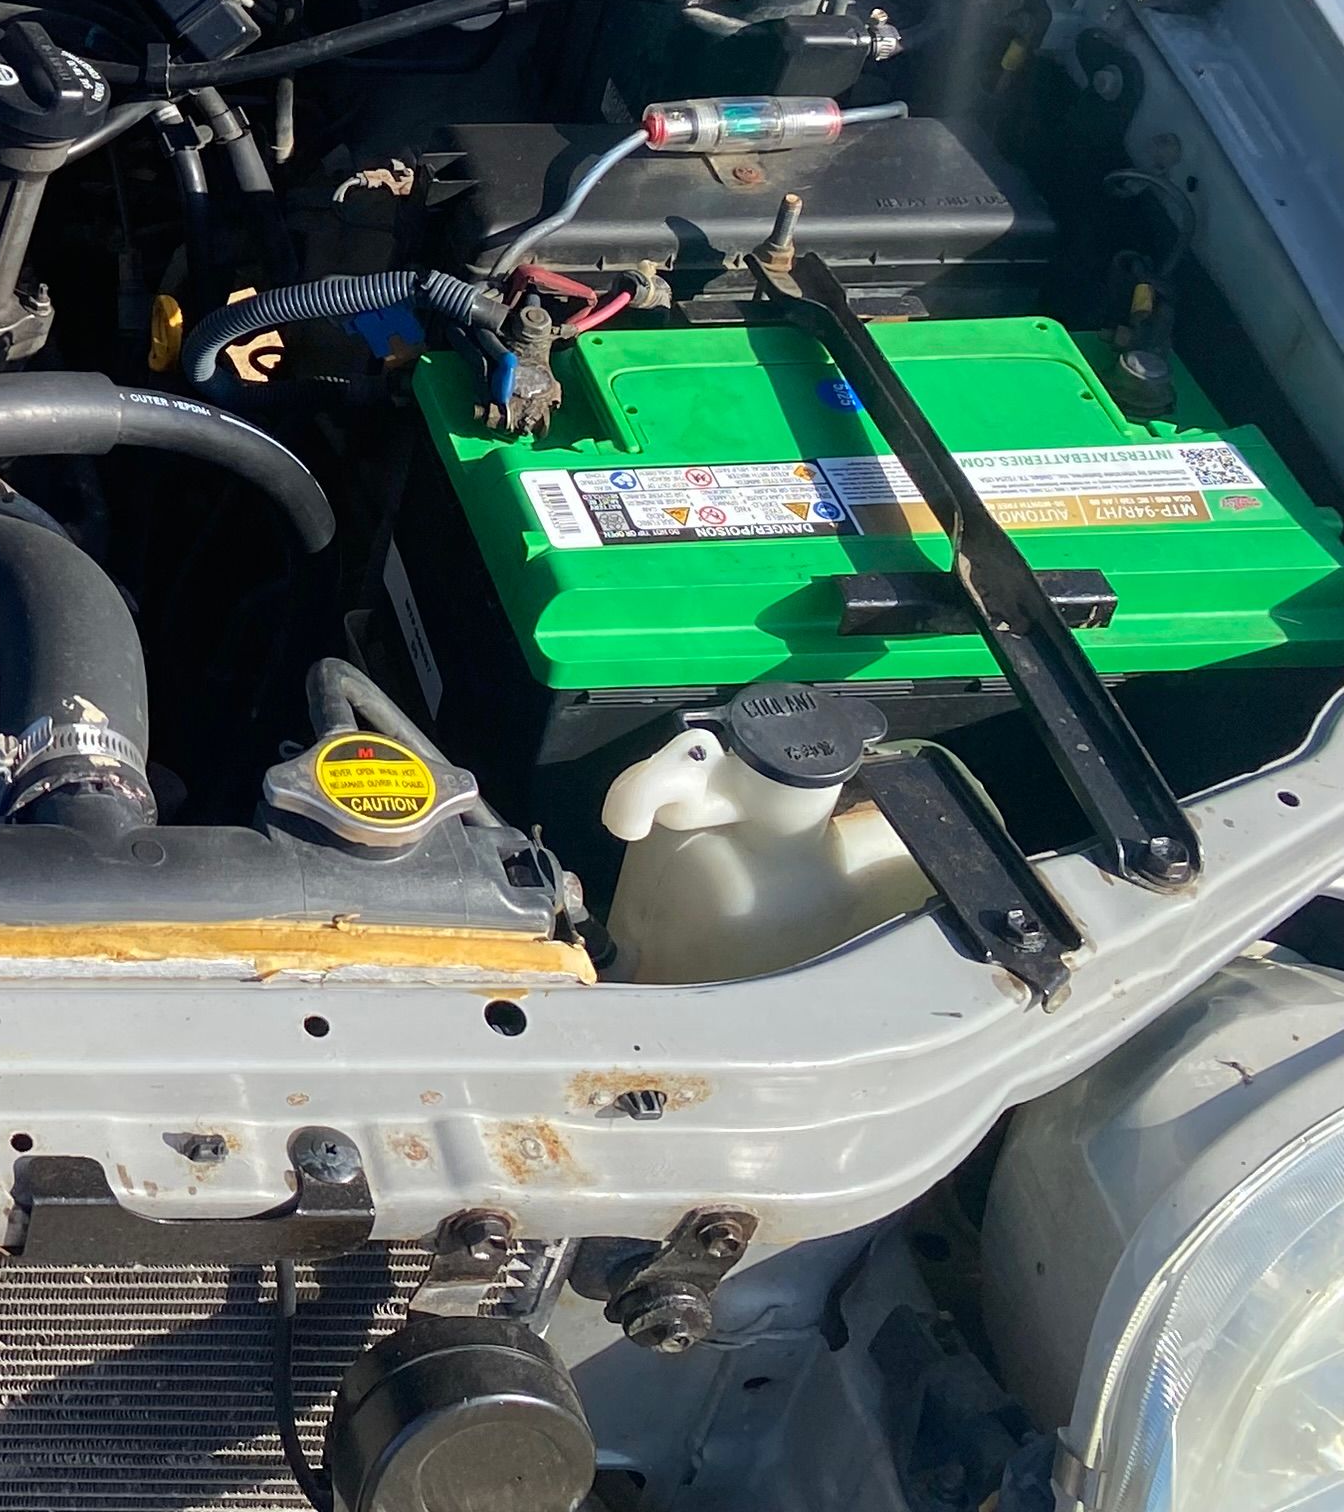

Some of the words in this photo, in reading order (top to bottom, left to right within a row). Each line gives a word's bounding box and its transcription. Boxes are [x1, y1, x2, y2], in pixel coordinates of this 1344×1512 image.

[130, 393, 169, 407] OUTER
[958, 448, 1174, 469] INTERSTATEBATTERIES.COM
[1096, 503, 1198, 520] MTP-94R/H7
[695, 523, 814, 537] DANGER/POISON
[741, 691, 816, 718] COOLANT
[356, 768, 374, 776] OPEN
[350, 797, 419, 812] CAUTION
